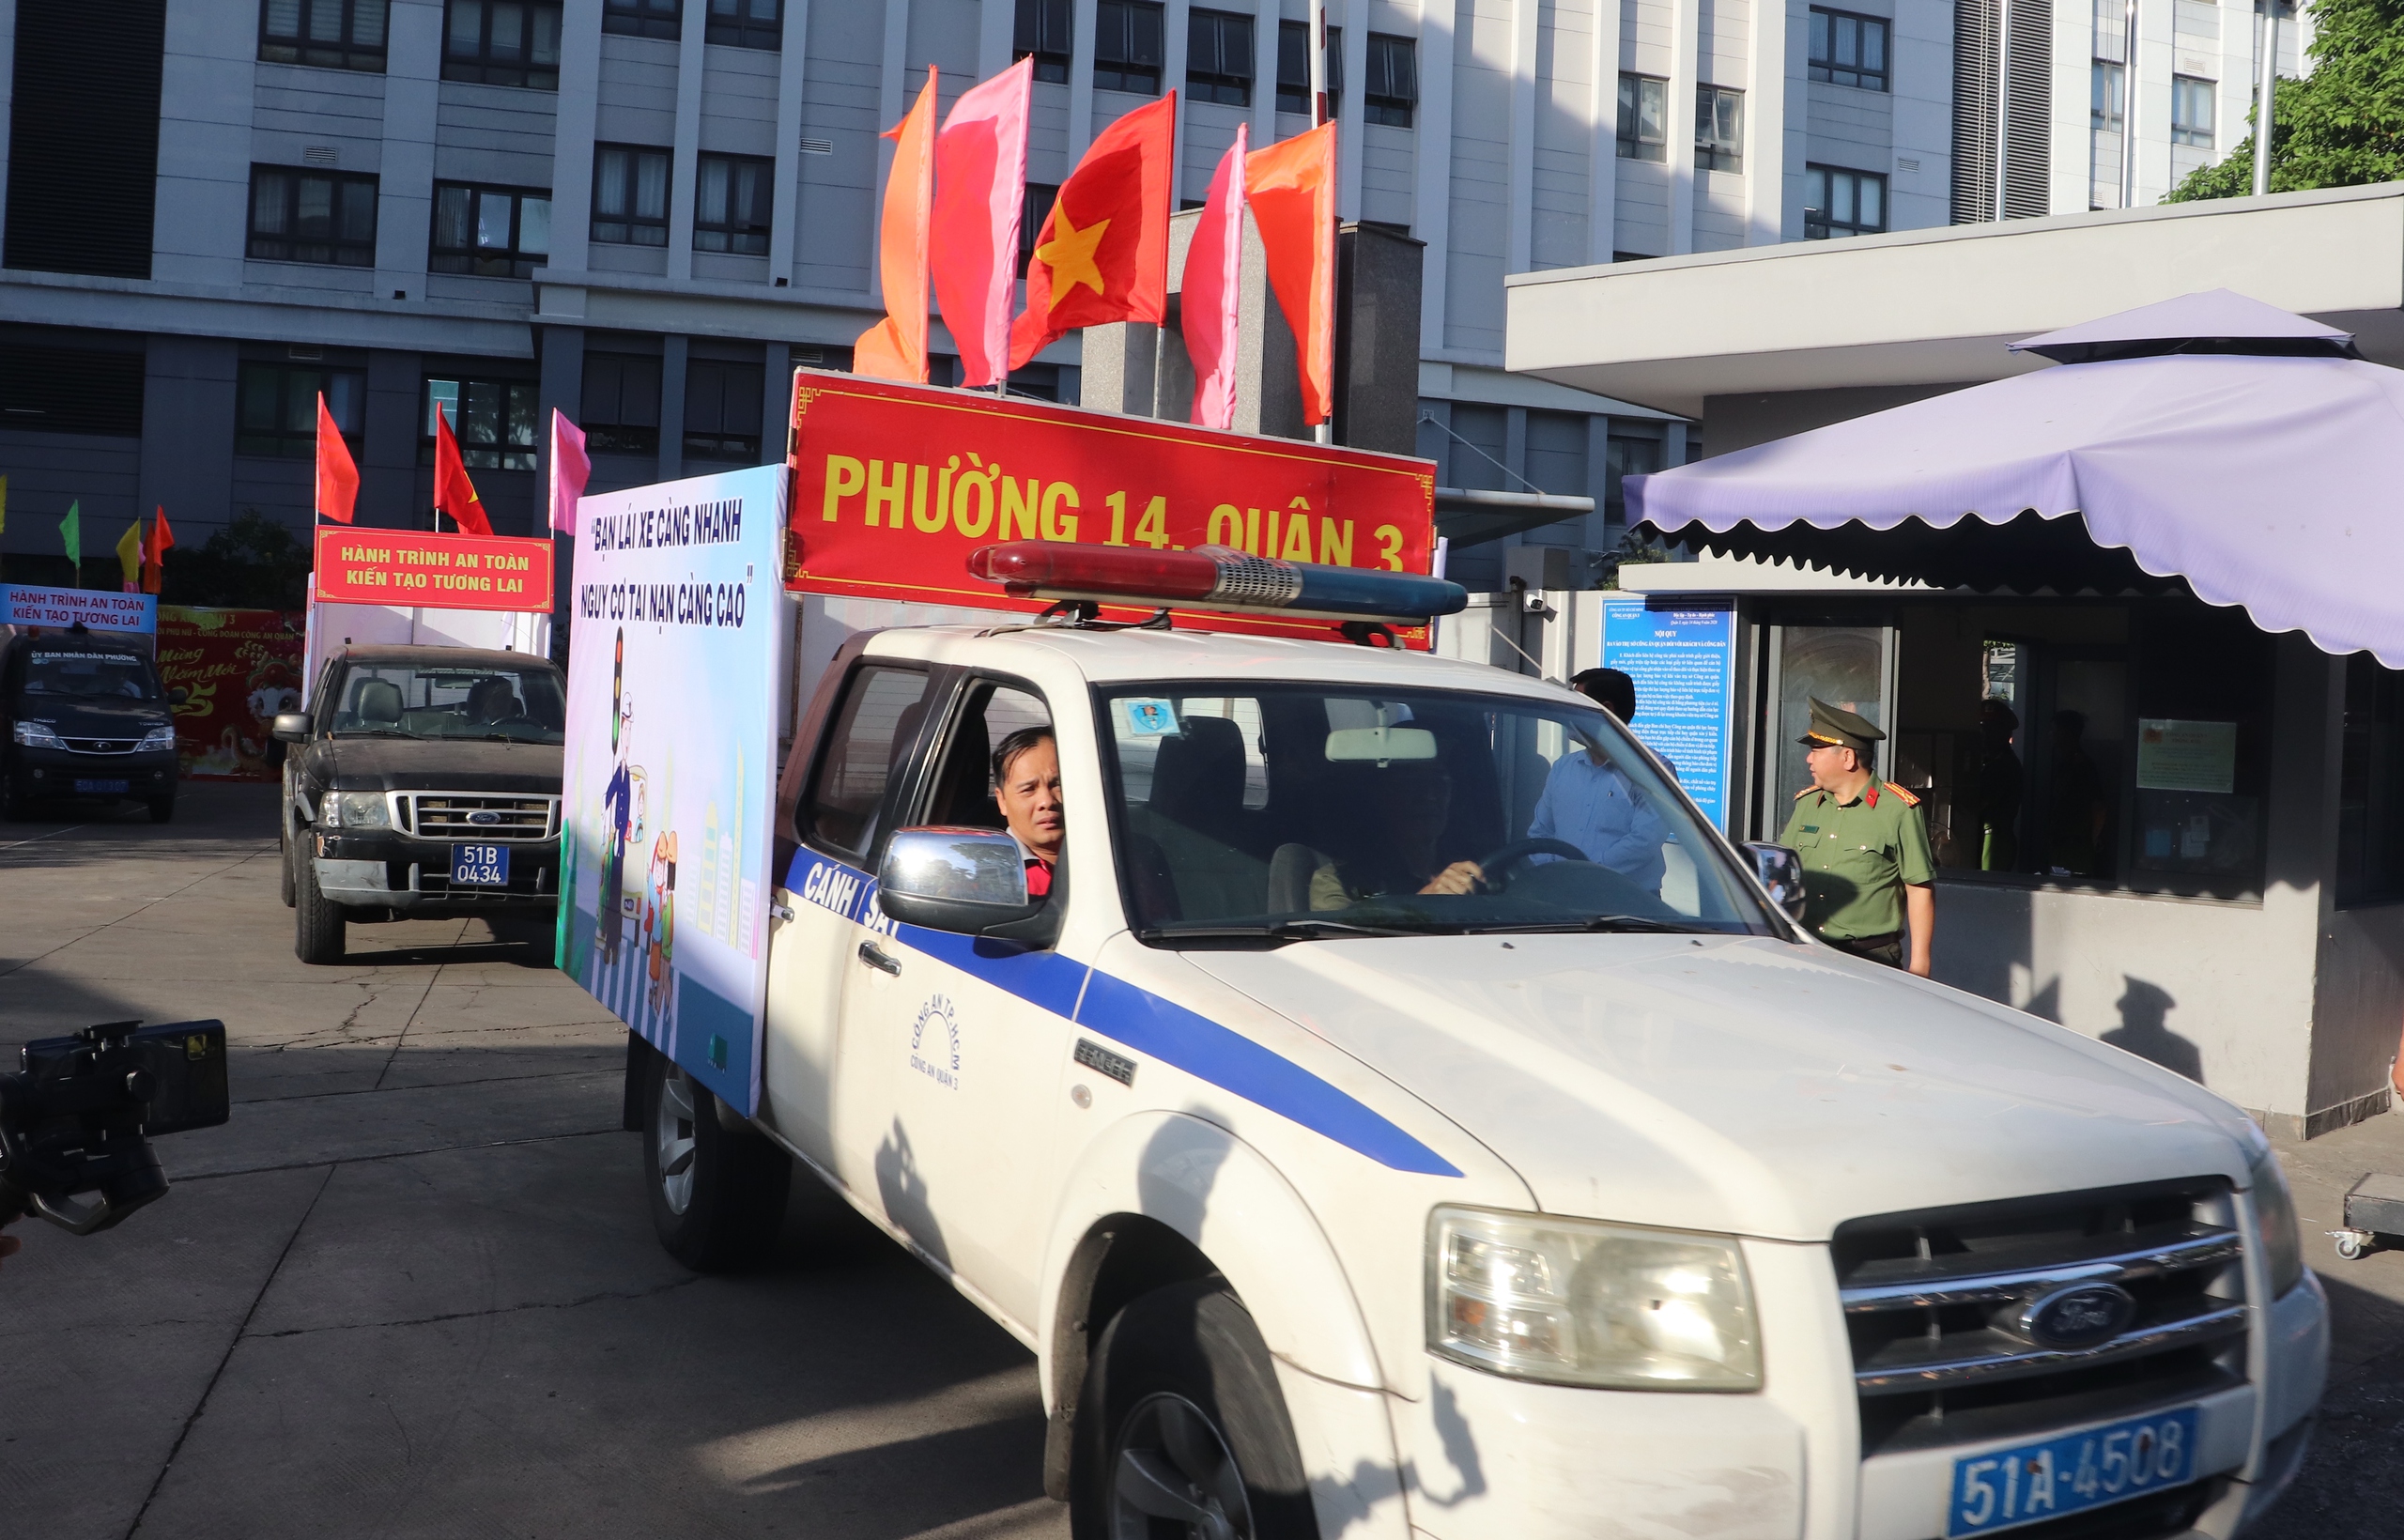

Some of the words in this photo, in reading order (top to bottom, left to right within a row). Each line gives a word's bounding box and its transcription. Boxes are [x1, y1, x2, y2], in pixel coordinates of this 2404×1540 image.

[618, 502, 637, 550] LÁI
[638, 510, 655, 548] XE
[656, 497, 690, 547] CÀNG
[693, 498, 743, 546] NHANH
[821, 452, 1081, 544] PHƯỜNG
[1102, 490, 1185, 551] 14
[1373, 524, 1404, 573] 3
[341, 544, 391, 563] HÀNH
[396, 547, 450, 566] TRÌNH
[455, 553, 479, 568] AN
[484, 552, 529, 571] TOÀN
[346, 565, 387, 587] KIẾN
[393, 572, 427, 591] TẠO
[432, 573, 491, 592] TƯƠNG
[497, 578, 523, 593] LAI
[9, 590, 47, 604] HÀNH
[50, 593, 87, 607] TRÌNH
[90, 597, 108, 608] AN
[111, 597, 145, 611] TOÀN
[580, 583, 609, 620] NGUY
[628, 583, 647, 622] TAI
[649, 583, 675, 635] NẠN
[678, 572, 714, 626] CÀNG
[13, 605, 41, 620] KIẾN
[45, 609, 69, 624] TẠO
[72, 611, 118, 625] TƯƠNG
[122, 615, 140, 626] LAI
[1654, 630, 1664, 639] NỘI
[62, 651, 85, 659] NHÂN
[86, 652, 104, 660] DÂN
[464, 846, 498, 865] 51B
[457, 865, 501, 884] 0434
[804, 861, 861, 917] CẢNH
